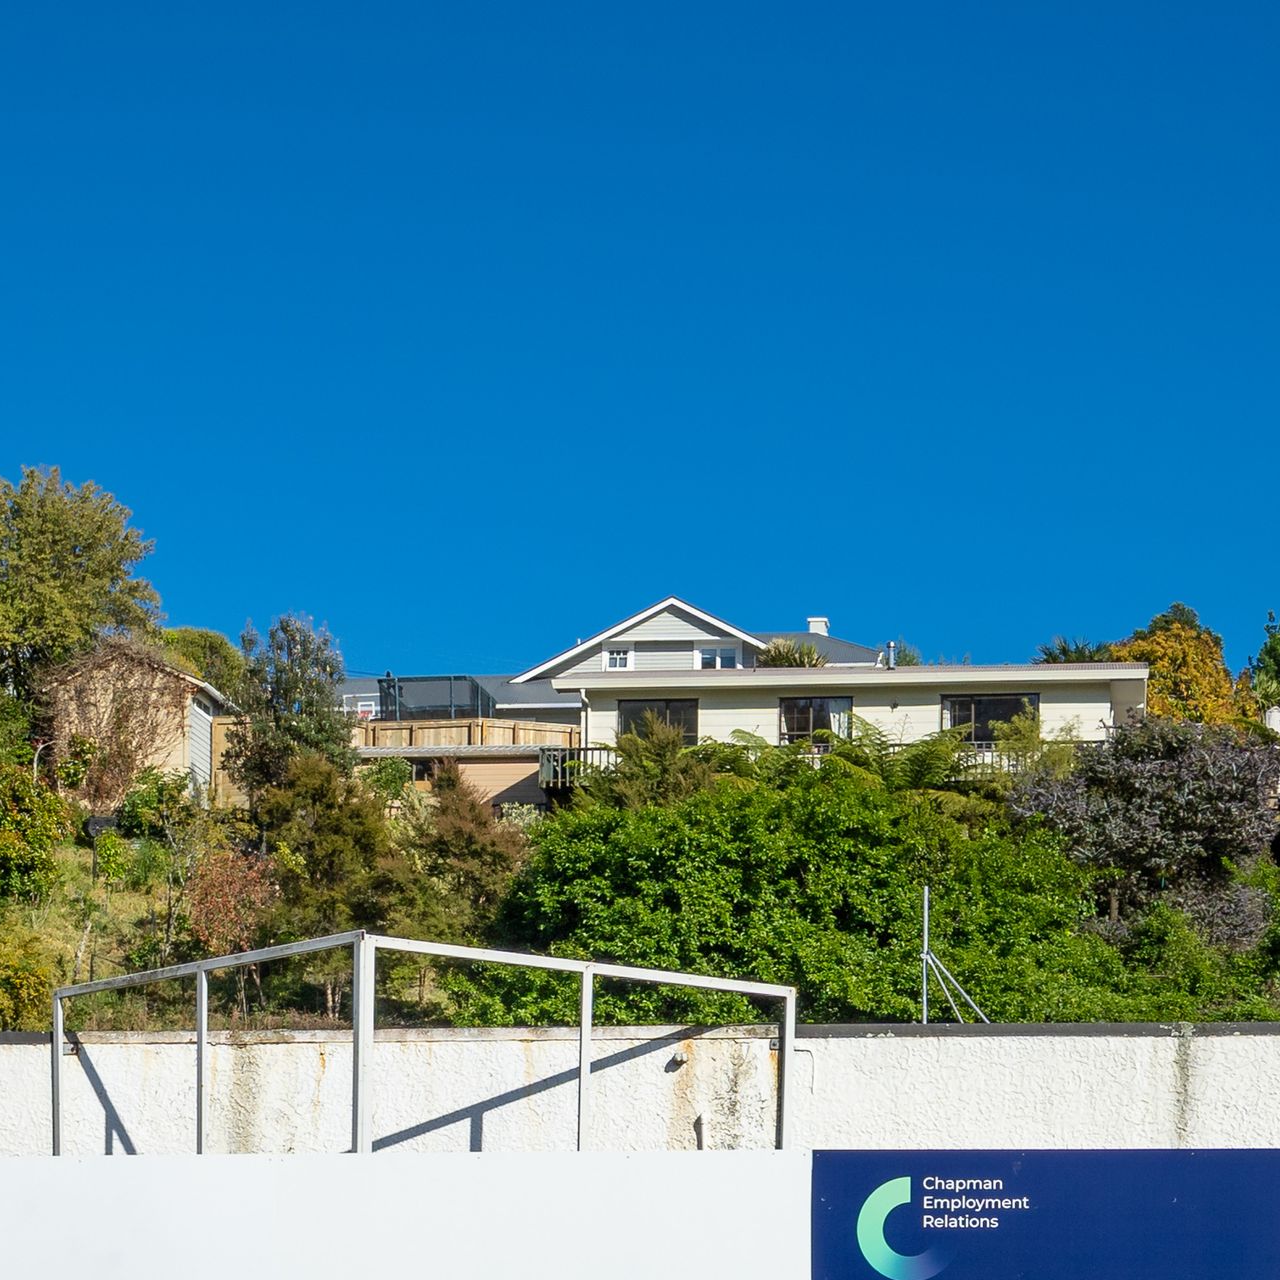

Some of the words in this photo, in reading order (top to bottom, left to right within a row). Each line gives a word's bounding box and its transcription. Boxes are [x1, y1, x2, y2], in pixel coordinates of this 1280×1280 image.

[922, 1176, 1003, 1193] Chapman
[923, 1195, 1030, 1212] Employment
[923, 1214, 999, 1228] Relations
